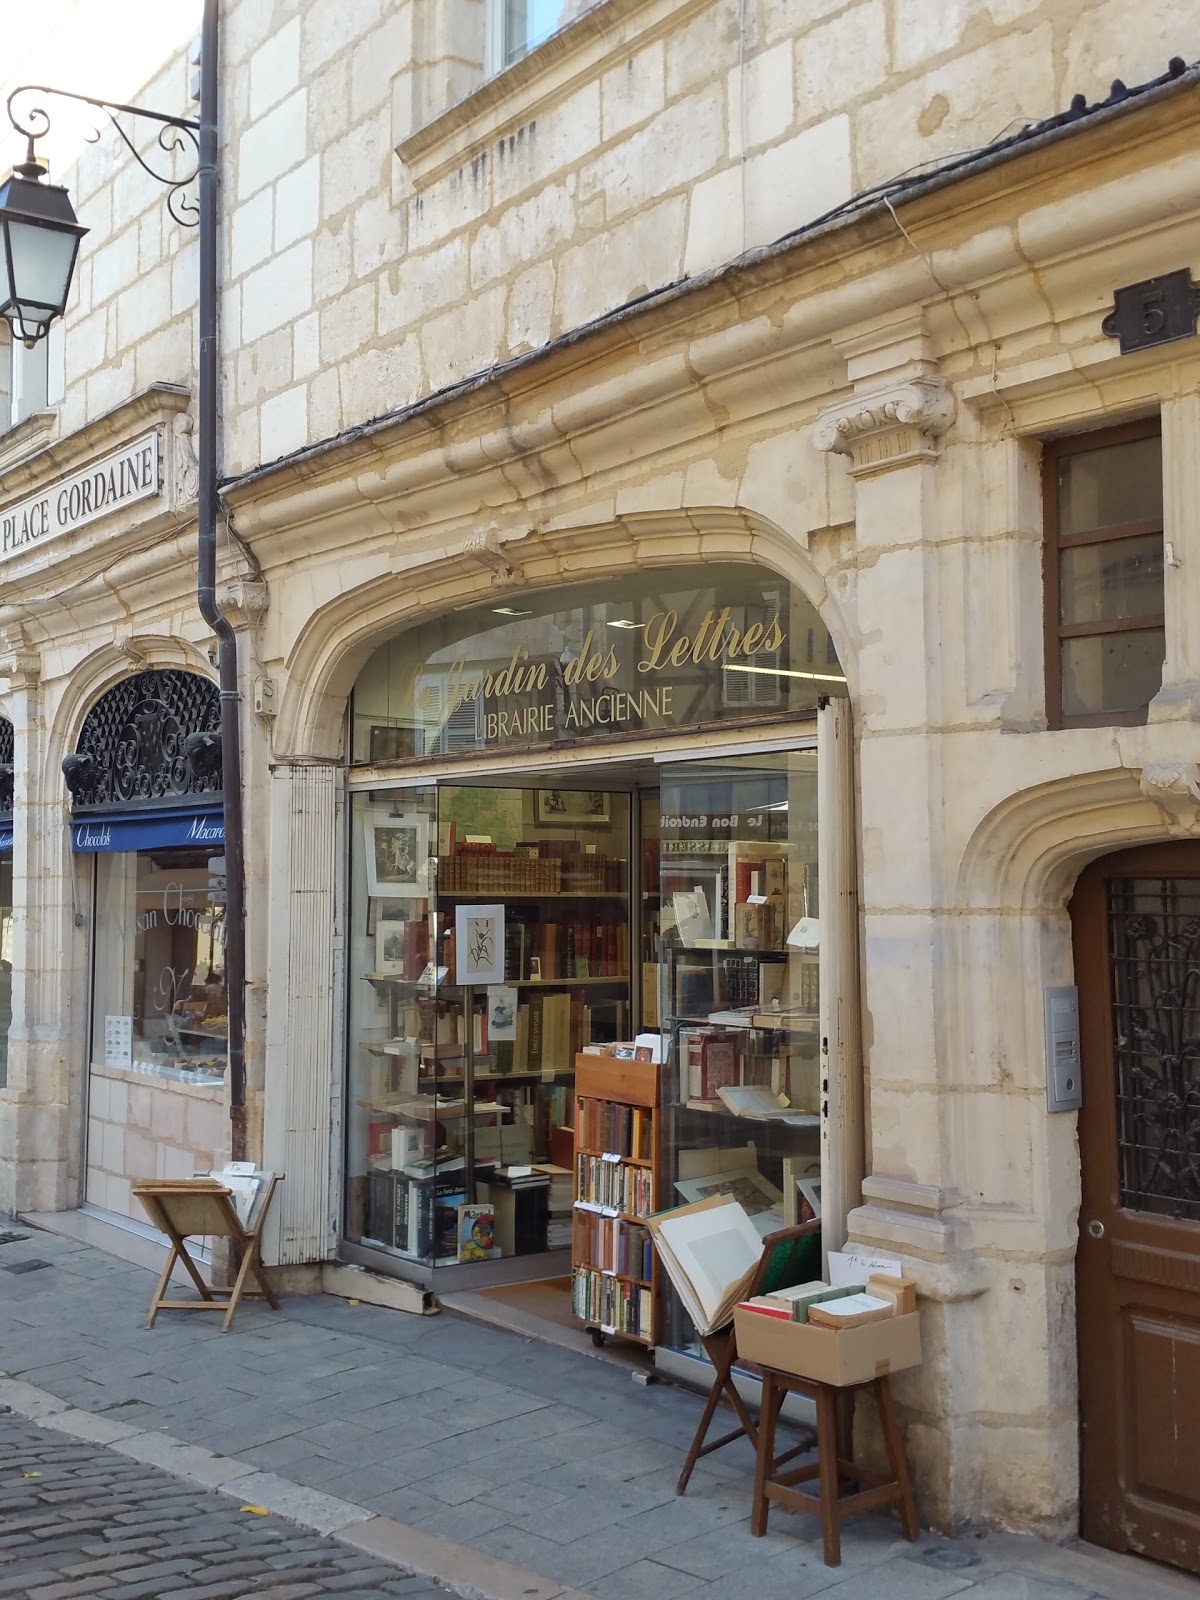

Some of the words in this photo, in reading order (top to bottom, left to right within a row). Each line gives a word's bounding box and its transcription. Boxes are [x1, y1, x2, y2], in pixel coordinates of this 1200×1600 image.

[1143, 289, 1166, 335] 5
[3, 499, 50, 552] PLACE
[56, 447, 153, 526] GORDAINE
[438, 645, 549, 724] Jardin
[563, 630, 621, 685] des
[637, 606, 787, 673] Lettres
[474, 704, 554, 740] LIBRAIRIE
[565, 687, 673, 729] ANCIENNE
[77, 824, 111, 848] Chocolats
